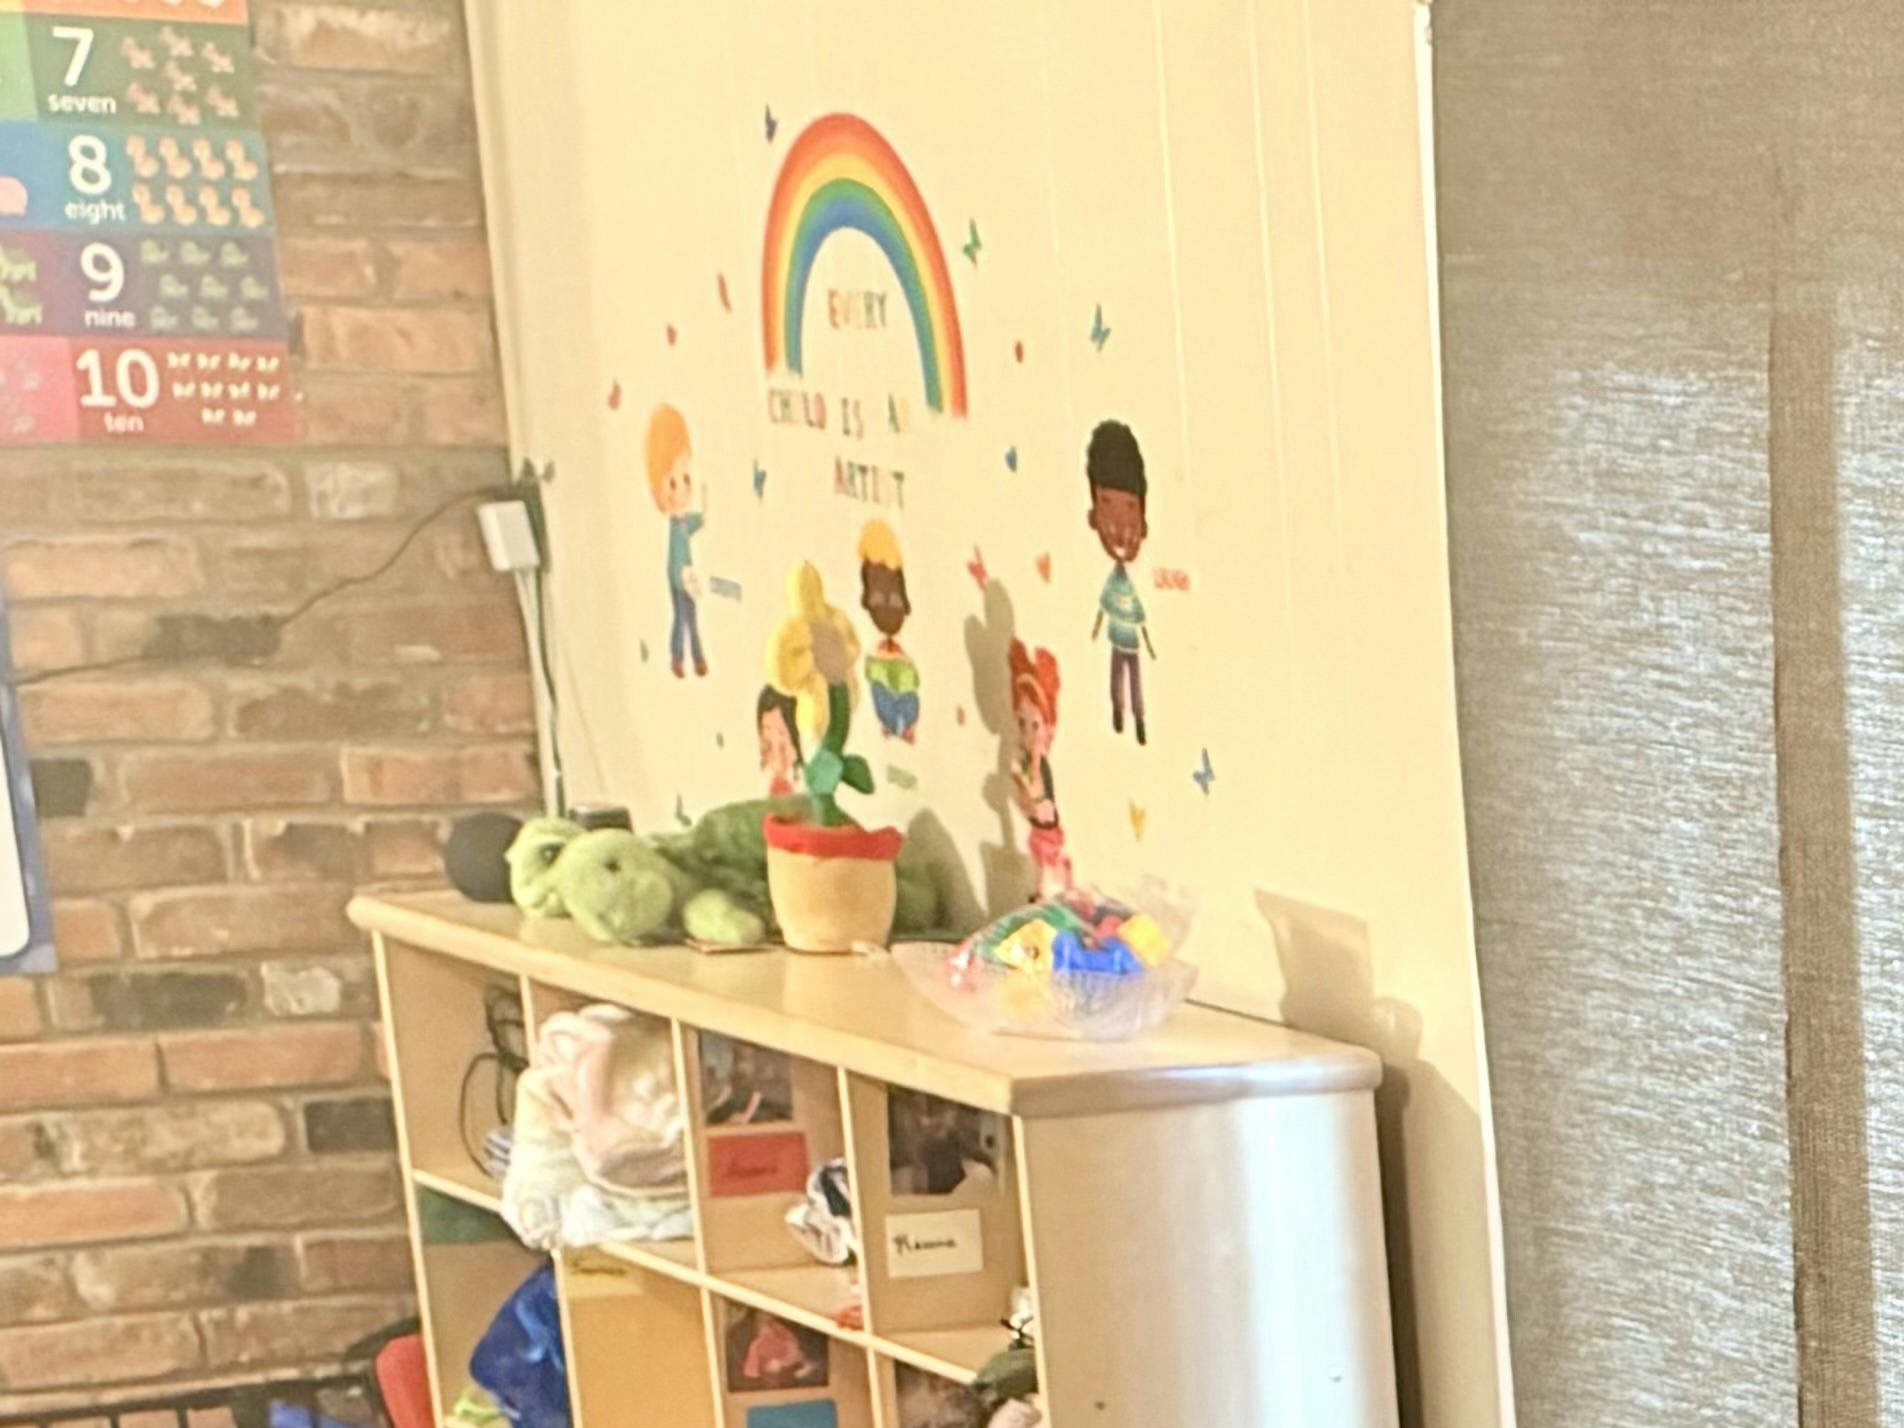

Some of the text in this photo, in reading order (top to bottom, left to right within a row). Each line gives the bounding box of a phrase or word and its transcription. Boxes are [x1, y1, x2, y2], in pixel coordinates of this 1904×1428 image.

[52, 26, 94, 87] 7
[48, 93, 118, 114] seven
[67, 134, 112, 195] 8
[64, 200, 126, 223] eight
[80, 242, 125, 302] 9
[84, 308, 136, 329] nine
[76, 348, 160, 409] 10
[104, 412, 145, 434] ten
[842, 397, 864, 439] IS
